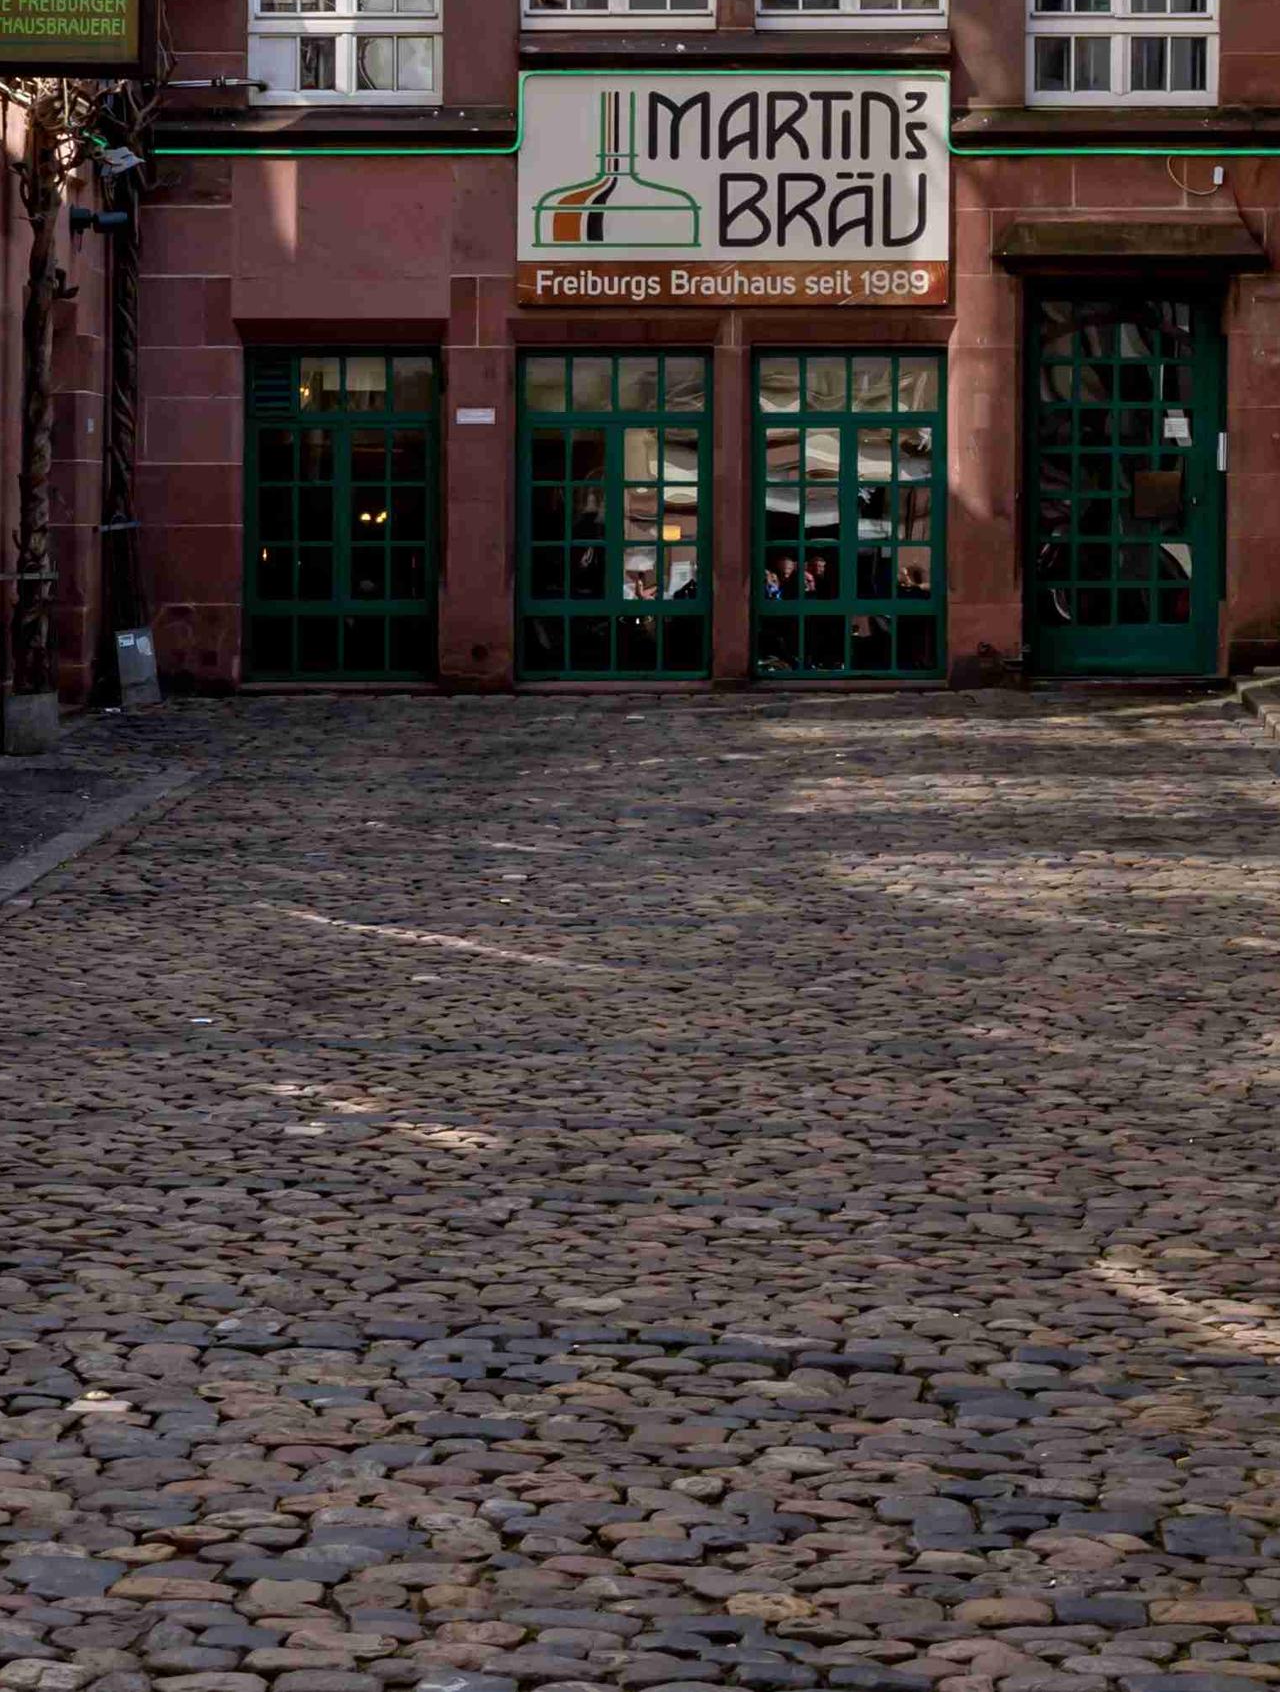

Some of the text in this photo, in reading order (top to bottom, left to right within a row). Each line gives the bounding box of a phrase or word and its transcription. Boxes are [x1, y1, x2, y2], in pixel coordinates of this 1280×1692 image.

[718, 172, 927, 248] BRÄU
[536, 269, 930, 301] Freiburgs Brauhaus seit 1989
